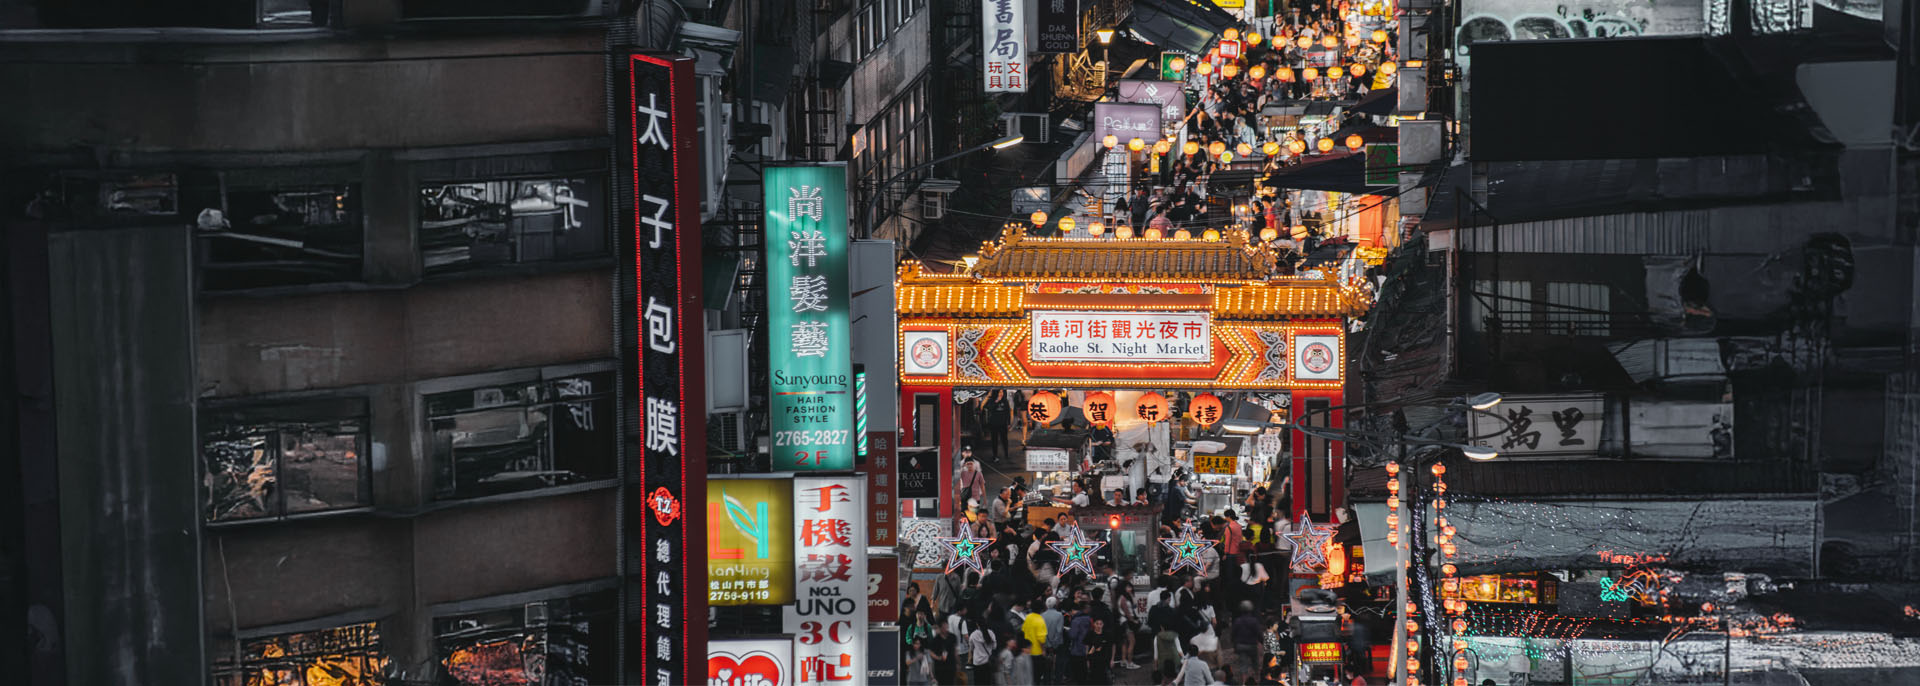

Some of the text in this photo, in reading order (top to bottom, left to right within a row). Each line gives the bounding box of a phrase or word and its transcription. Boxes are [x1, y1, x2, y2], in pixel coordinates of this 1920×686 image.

[987, 61, 1003, 89] 玩具
[1006, 61, 1022, 89] 文具
[637, 93, 678, 457] 太子包膜
[788, 184, 831, 359] 尚洋髮藝
[1040, 319, 1203, 340] 饒河街觀光夜市
[1038, 342, 1205, 357] Raohe St. Night Market
[775, 369, 847, 389] Sunyoung
[785, 405, 836, 414] FASHION
[796, 396, 824, 404] HAIR
[793, 415, 829, 423] STYLE
[1501, 405, 1585, 450] 萬里
[775, 429, 849, 447] 2765-2827
[793, 450, 828, 466] 2F
[874, 438, 889, 541] 哈林運動世界
[798, 484, 851, 582] 手機殼
[710, 591, 769, 601] 2756-9119
[809, 587, 840, 596] NO.1
[796, 598, 855, 616] UNO
[799, 620, 852, 645] 3C
[799, 653, 852, 683] 配
